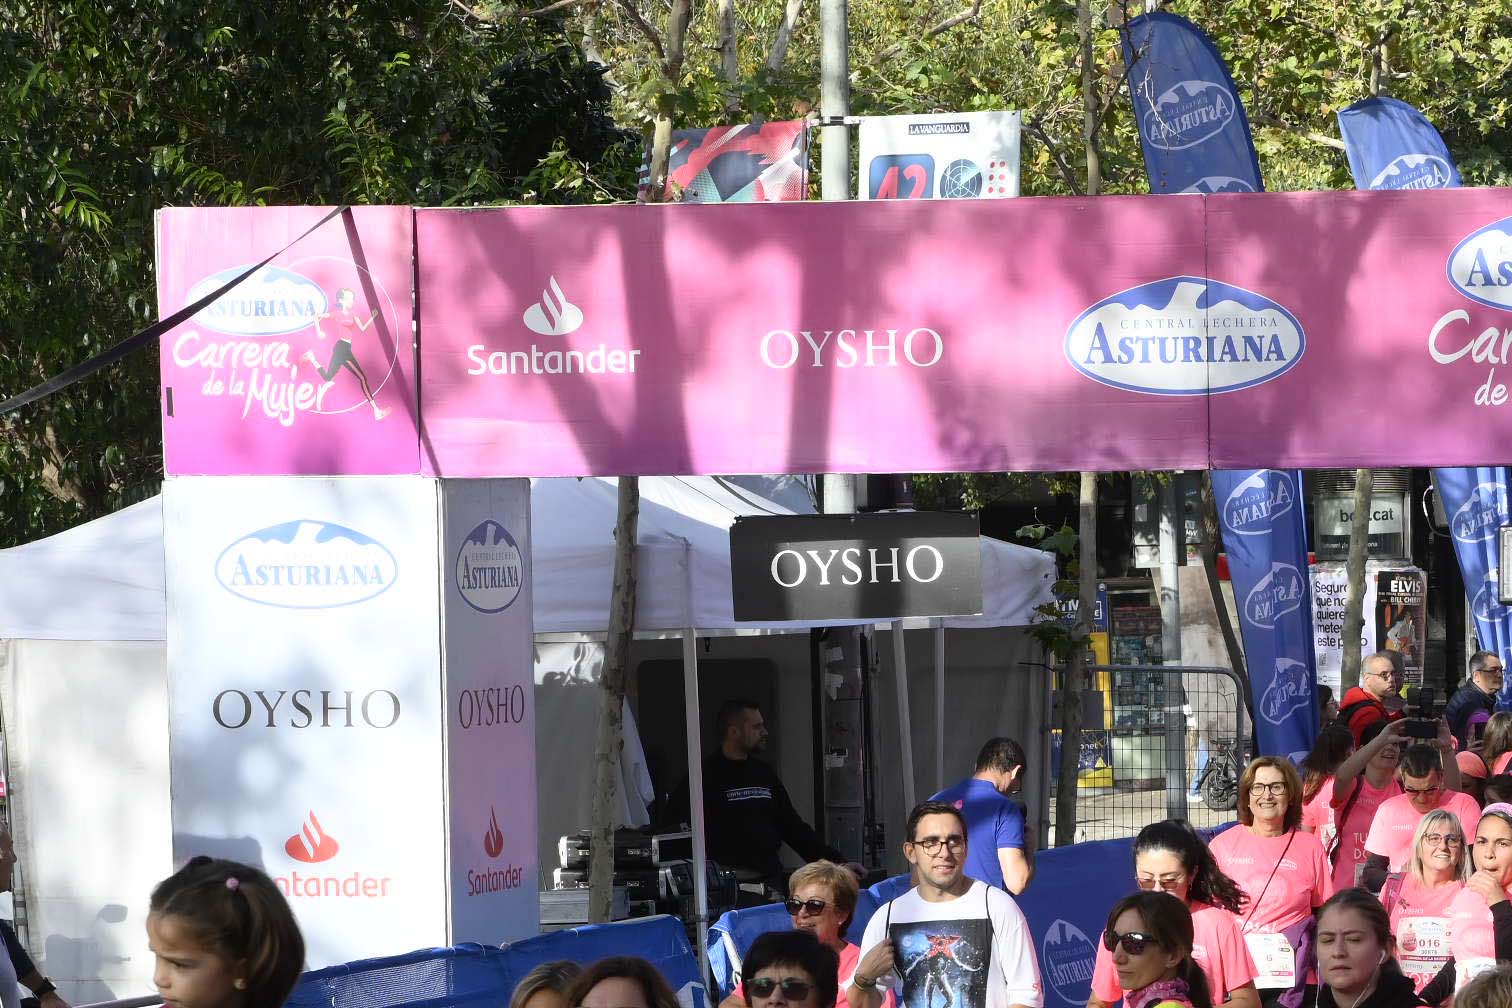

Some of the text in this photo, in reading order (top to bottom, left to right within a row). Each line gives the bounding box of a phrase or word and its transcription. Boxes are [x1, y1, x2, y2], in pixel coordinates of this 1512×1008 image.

[1120, 316, 1279, 330] CENTRAL LECHERA
[172, 331, 291, 369] Carrera
[760, 328, 944, 369] OYSHO
[1084, 321, 1286, 364] ASTURIANA
[467, 344, 641, 375] Santander
[202, 365, 335, 427] de la Mujer
[1474, 367, 1508, 406] de
[230, 553, 385, 586] ASTURIANA
[461, 555, 519, 590] ASTURIANA
[770, 544, 945, 588] OYSHO
[1390, 580, 1421, 593] ELVIS
[1316, 598, 1333, 609] que
[1317, 610, 1345, 623] quiere
[1318, 637, 1368, 649] este po
[212, 689, 401, 729] OYSHO
[459, 684, 525, 730] OYSHO
[273, 871, 391, 897] ntander
[468, 864, 523, 896] Santander
[1419, 939, 1440, 948] 016
